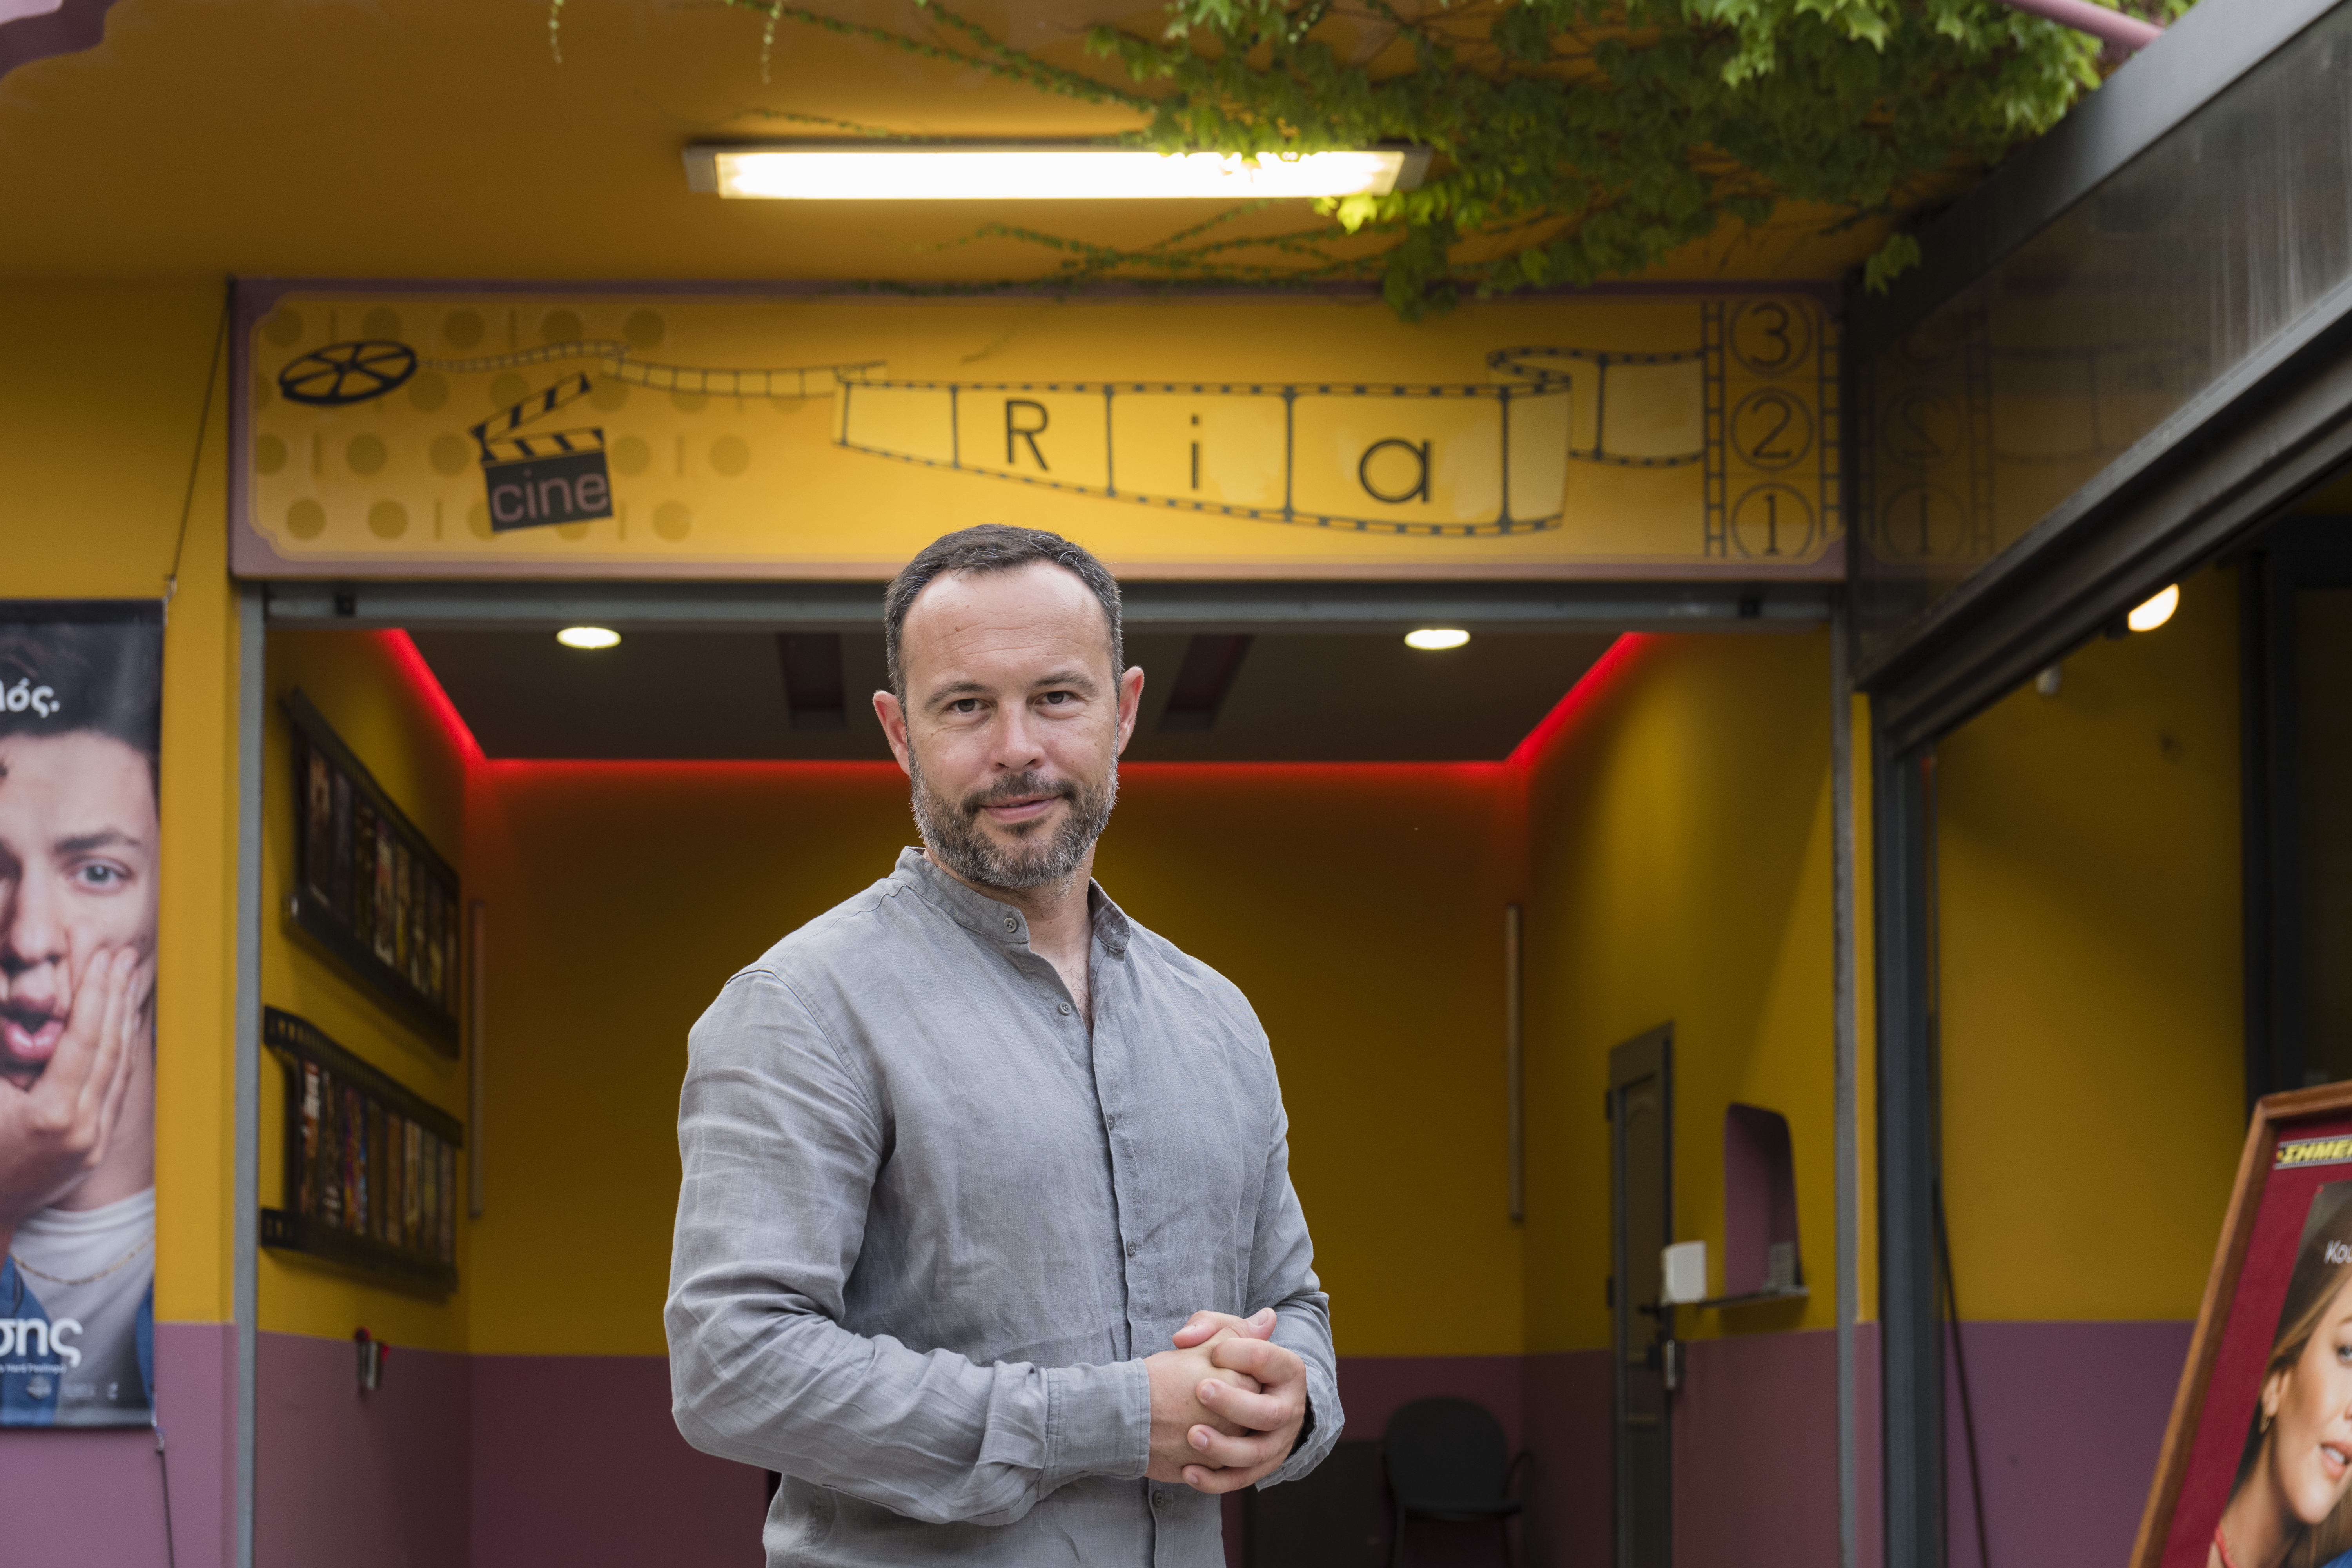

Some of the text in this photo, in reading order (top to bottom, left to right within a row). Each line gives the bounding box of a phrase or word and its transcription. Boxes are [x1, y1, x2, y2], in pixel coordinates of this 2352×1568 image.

[1749, 301, 1792, 367] 3
[1751, 395, 1793, 459] 2
[491, 468, 609, 523] cine
[1764, 493, 1779, 555] 1
[0, 677, 60, 718] ός.
